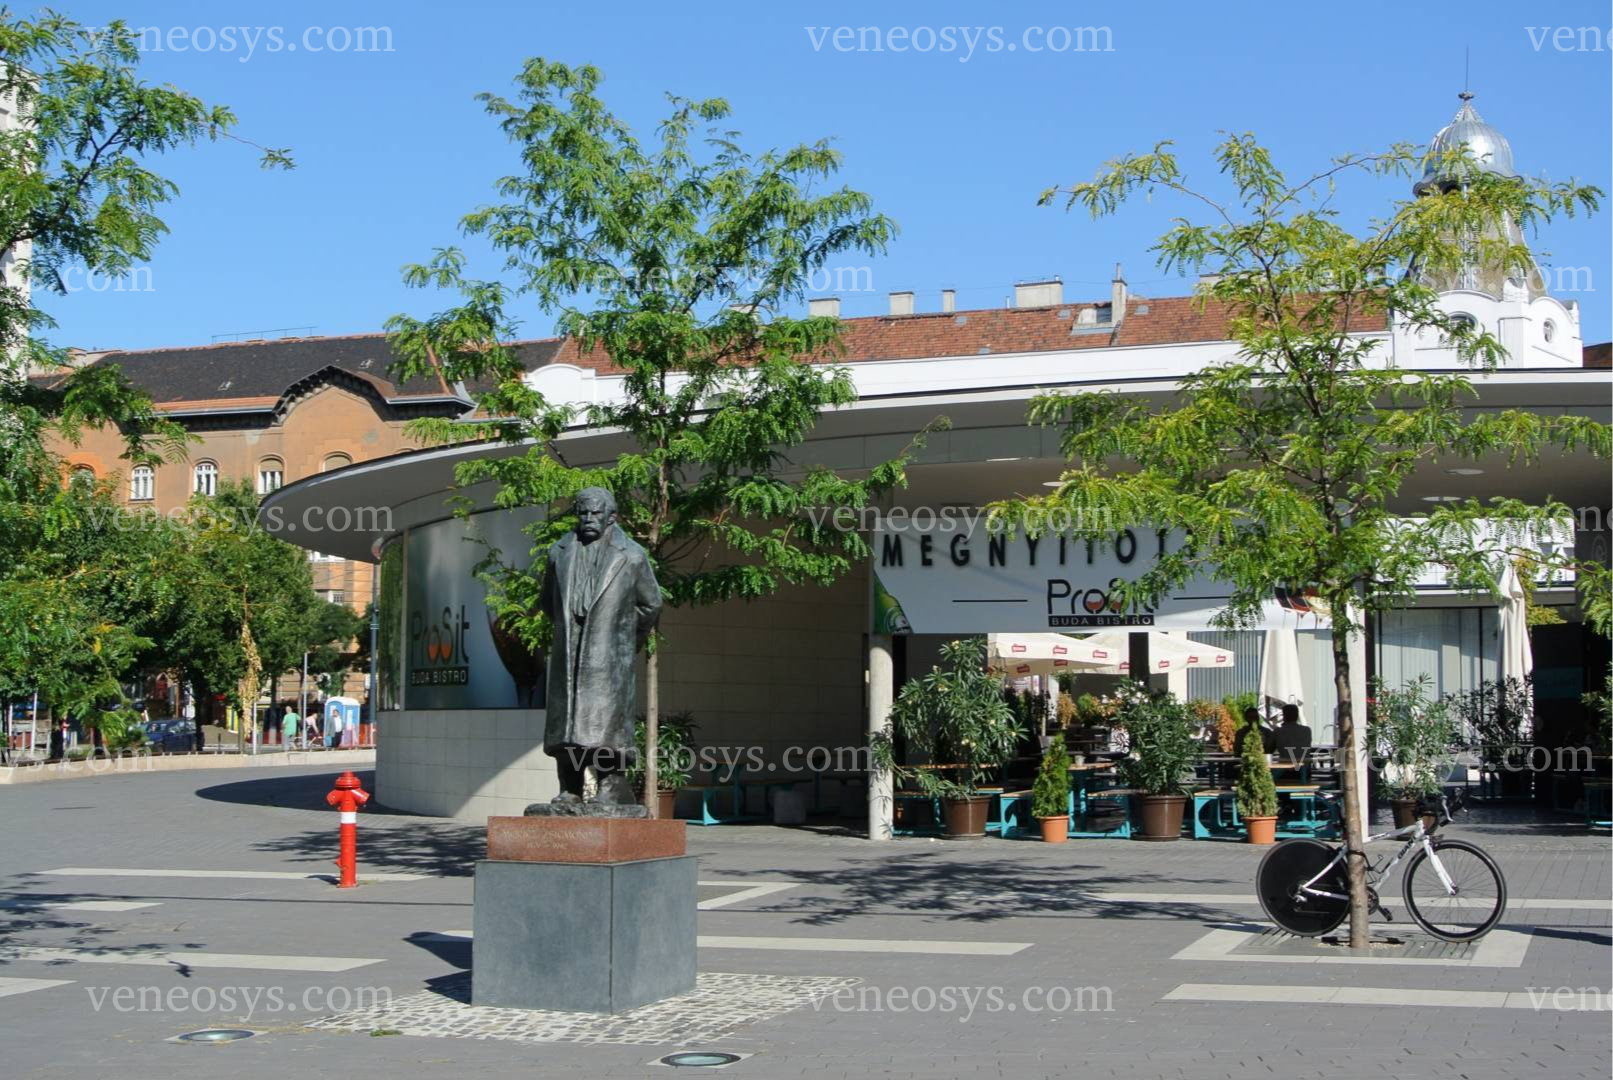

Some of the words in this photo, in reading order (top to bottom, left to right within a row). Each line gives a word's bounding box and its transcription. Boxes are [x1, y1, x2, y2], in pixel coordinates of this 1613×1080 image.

[1052, 617, 1089, 626] BUDA
[1097, 616, 1151, 626] BISTRO
[433, 670, 467, 683] BISTRO
